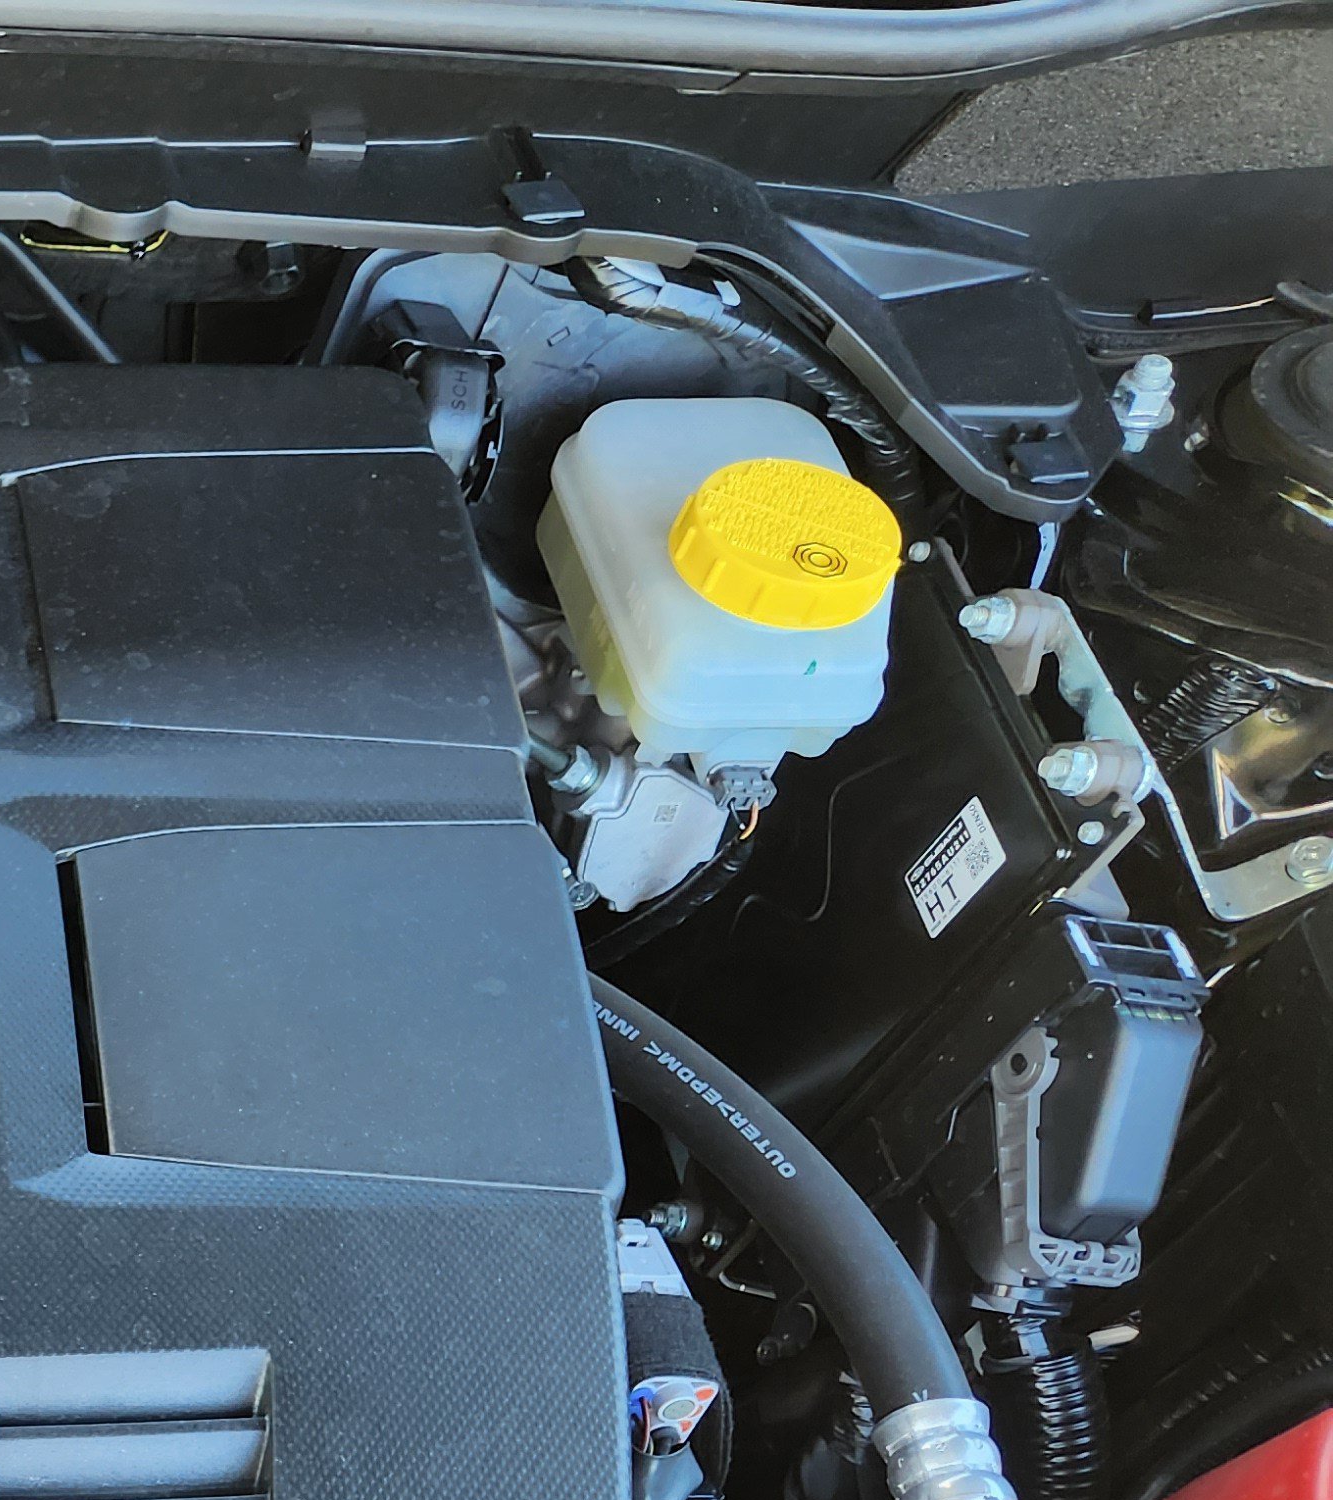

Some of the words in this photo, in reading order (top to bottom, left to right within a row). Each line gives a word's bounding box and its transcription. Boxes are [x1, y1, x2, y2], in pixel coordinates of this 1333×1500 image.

[968, 803, 987, 834] DENSO
[923, 820, 964, 868] SUBARU
[925, 873, 958, 923] HT
